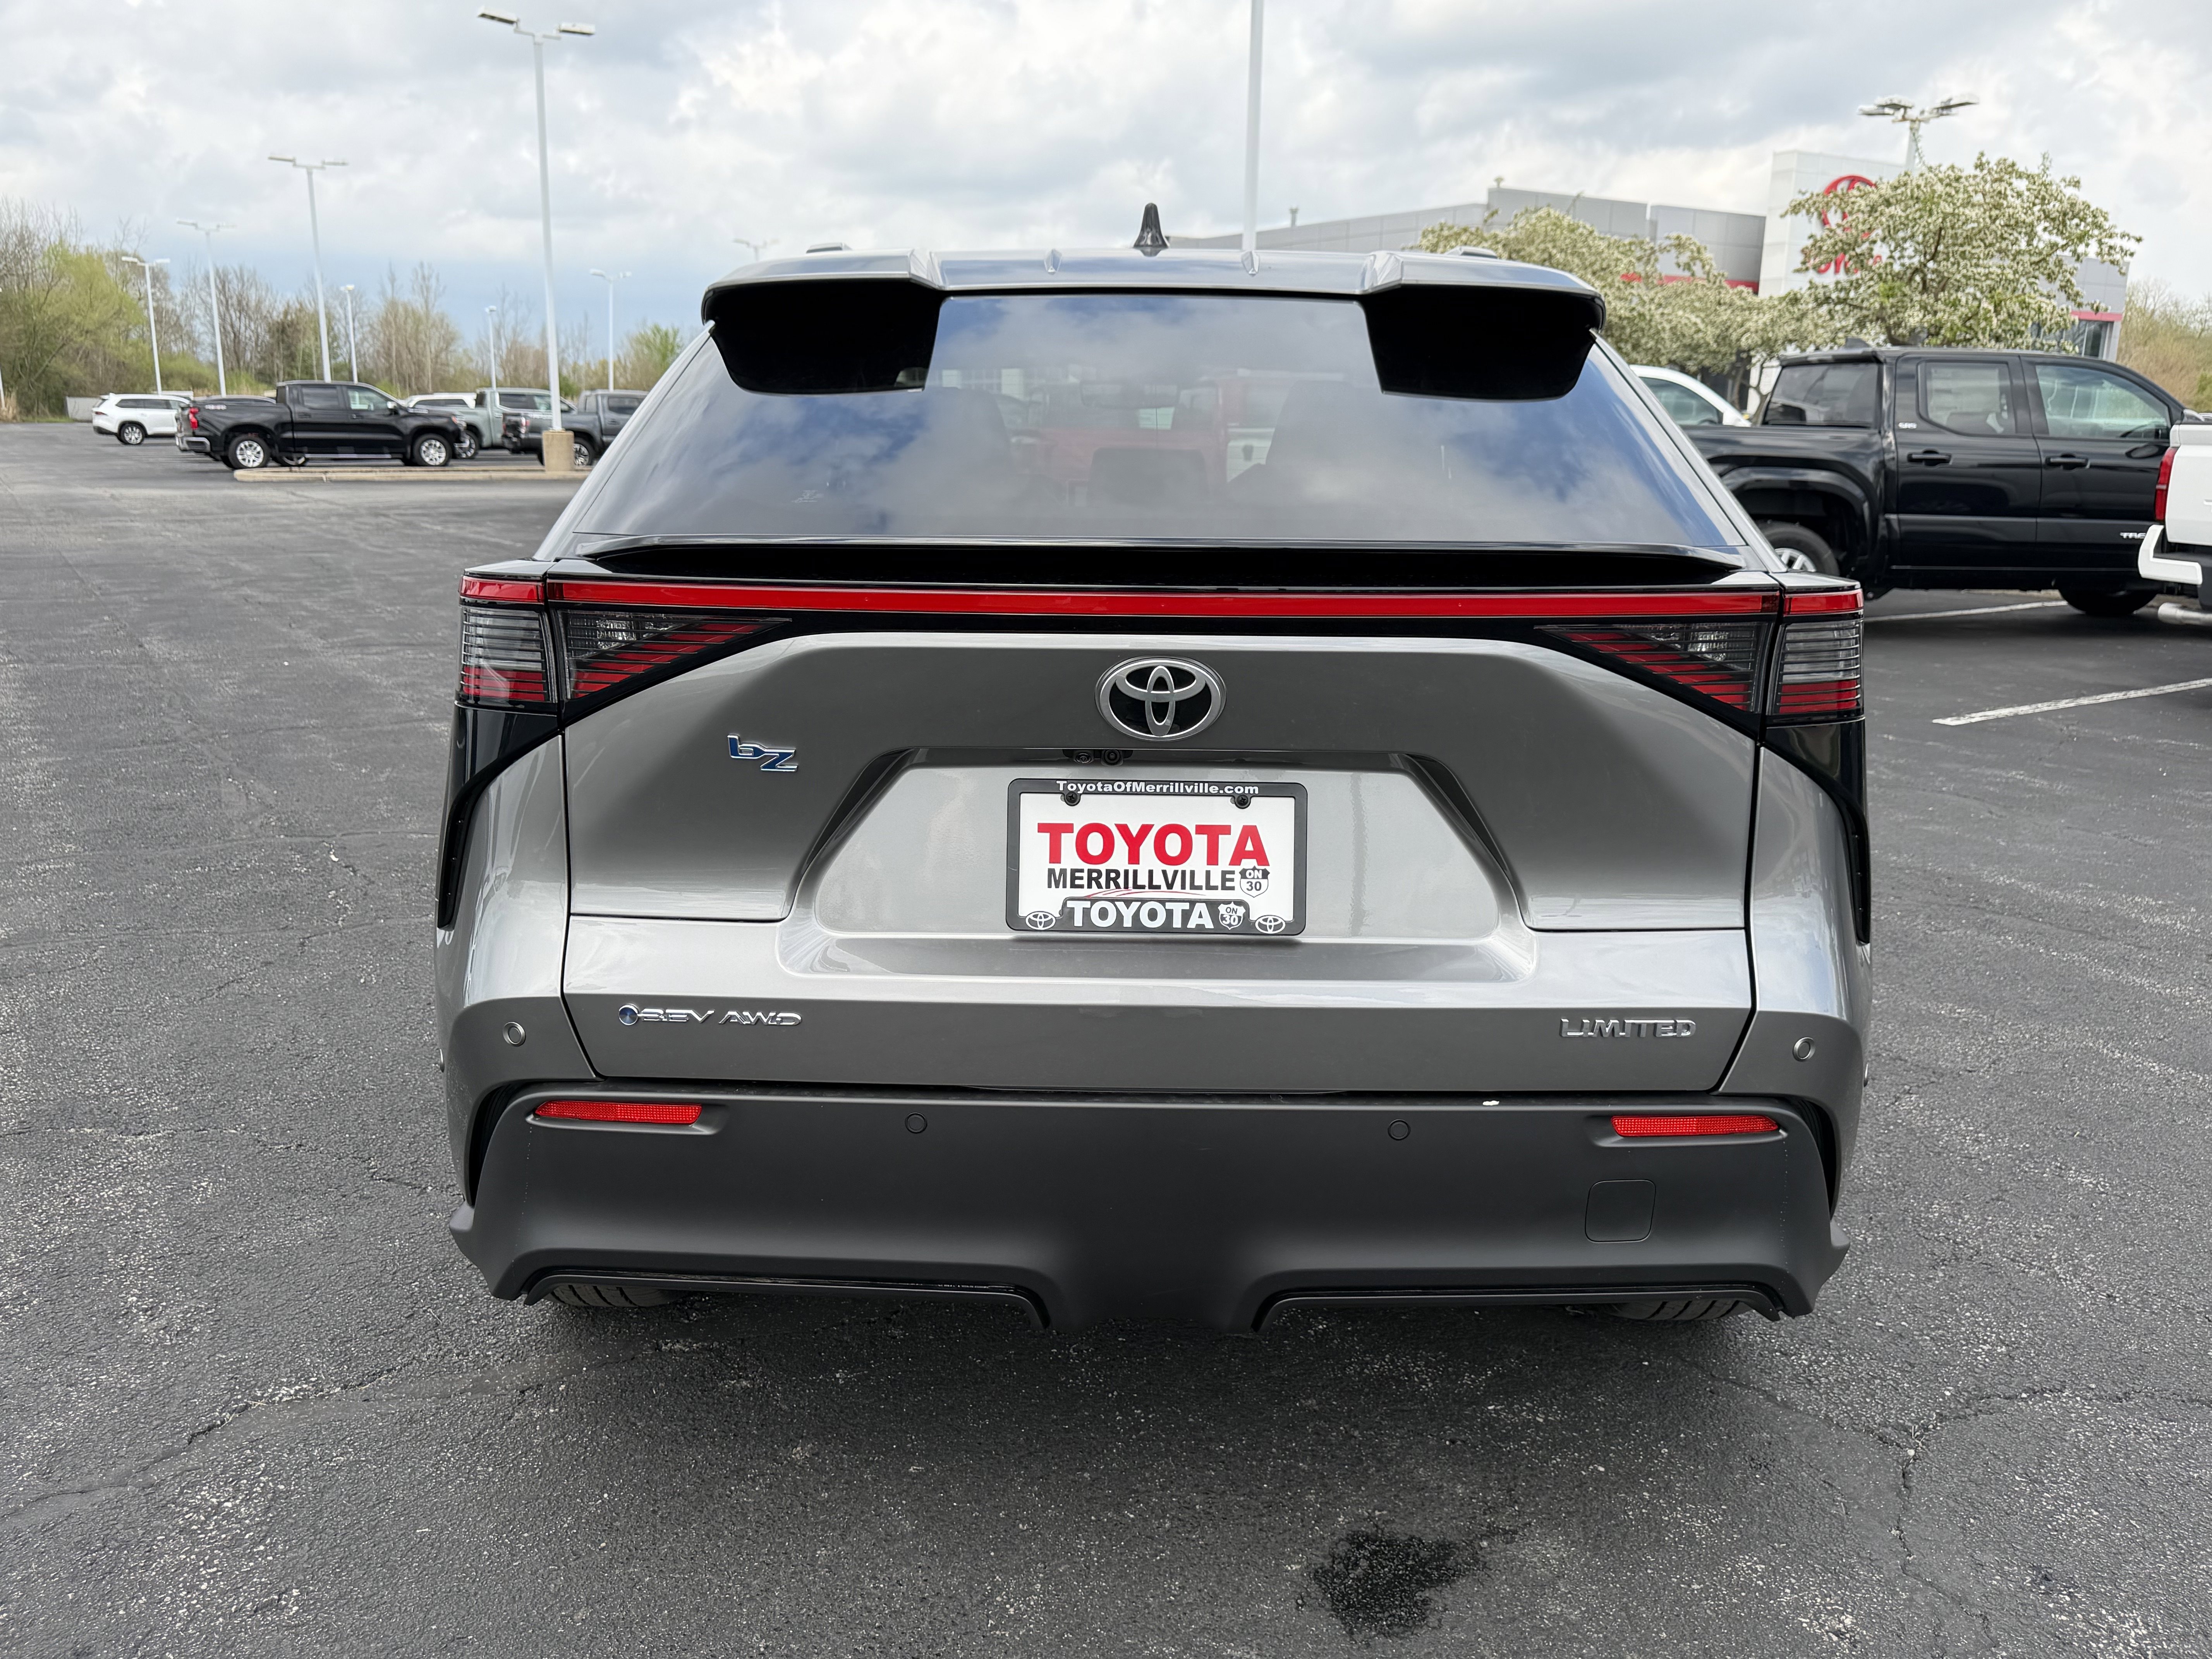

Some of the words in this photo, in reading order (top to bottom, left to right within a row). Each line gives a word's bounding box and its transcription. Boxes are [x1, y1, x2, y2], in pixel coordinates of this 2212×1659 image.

[1056, 780, 1259, 794] ToyotaOfMerrillville.com
[1037, 823, 1270, 866] TOYOTA
[1047, 868, 1235, 891] MERRILLVILLE
[1245, 869, 1262, 879] ON
[1246, 880, 1262, 891] 30
[1066, 900, 1214, 929] TOYOTA
[1225, 906, 1238, 915] ON
[1222, 914, 1239, 925] 30
[718, 1010, 803, 1025] AWD
[1559, 1018, 1697, 1038] LIMITED
